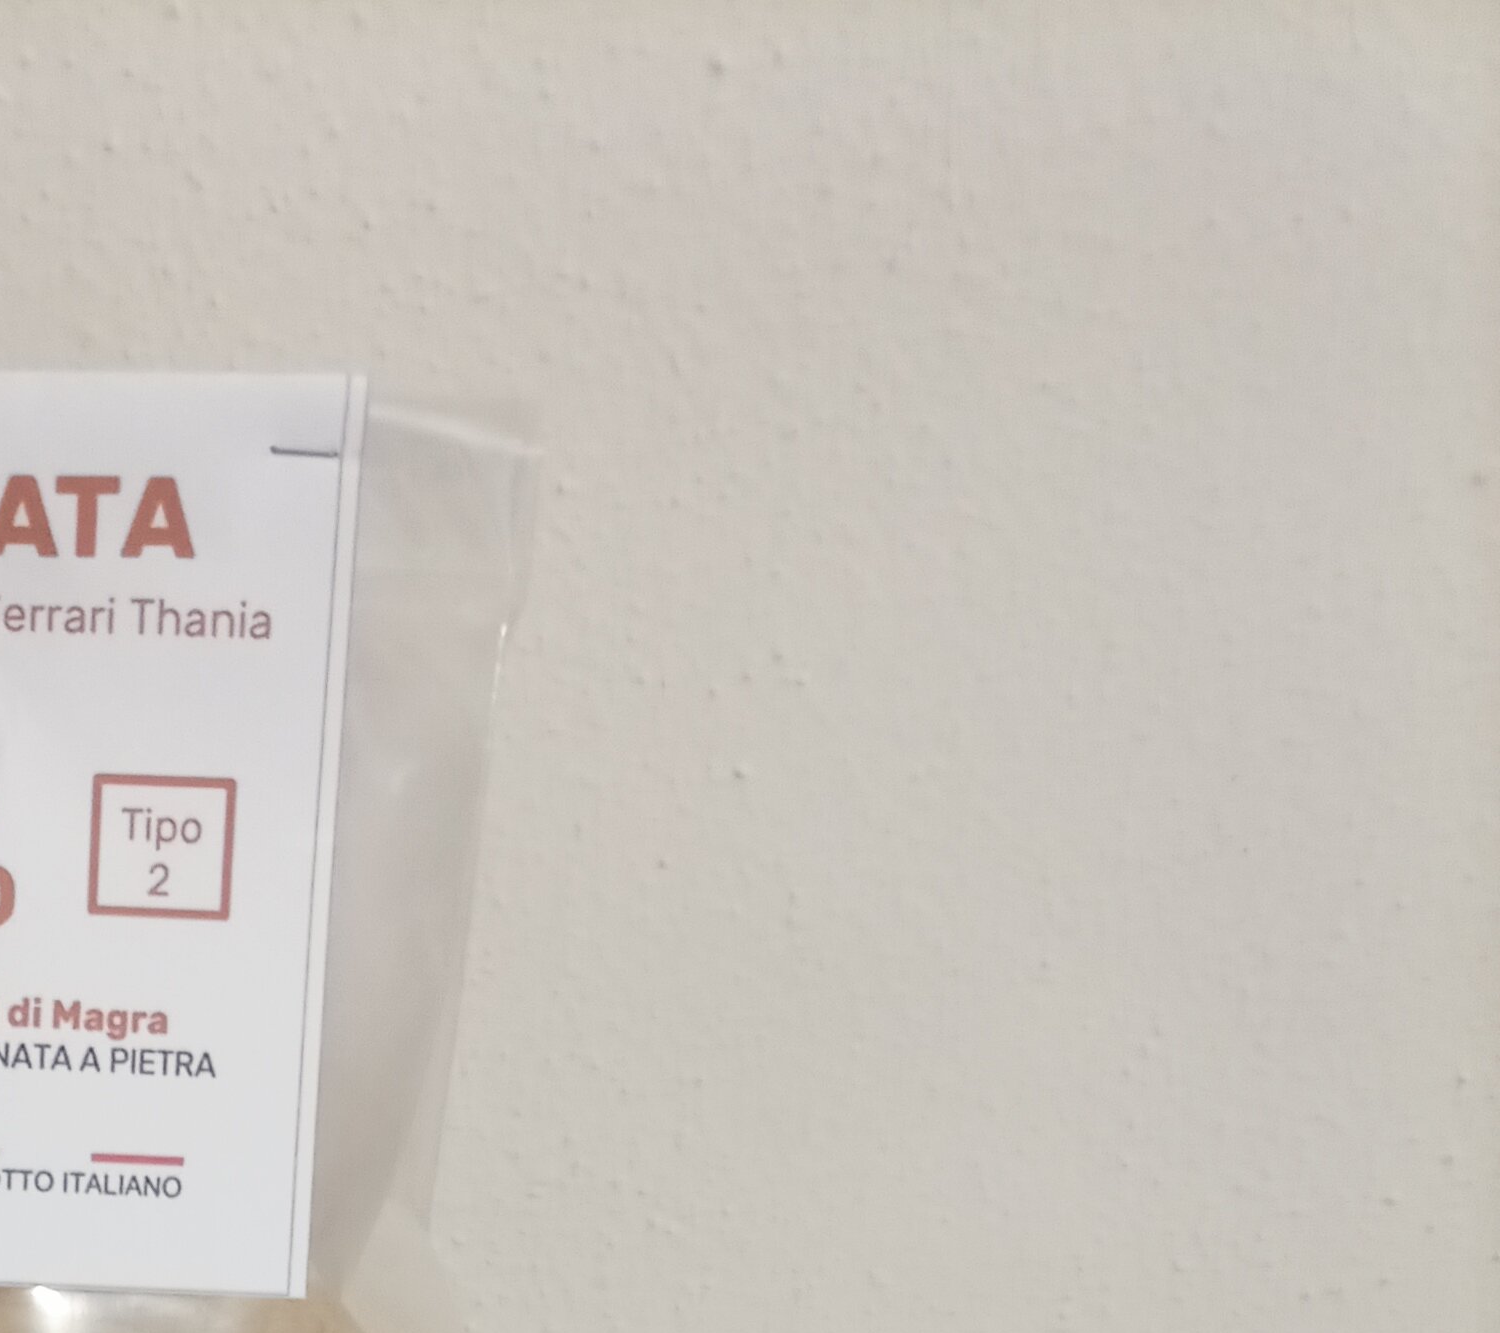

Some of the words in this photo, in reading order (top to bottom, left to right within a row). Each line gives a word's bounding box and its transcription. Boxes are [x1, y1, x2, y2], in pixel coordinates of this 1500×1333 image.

[130, 597, 272, 640] Thania
[121, 806, 203, 852] Tipo
[147, 862, 170, 897] 2
[7, 996, 42, 1029] di
[51, 999, 169, 1040] Magra
[79, 1046, 101, 1073] A
[110, 1047, 217, 1079] PIETRA
[62, 1171, 183, 1199] ITALIANO
